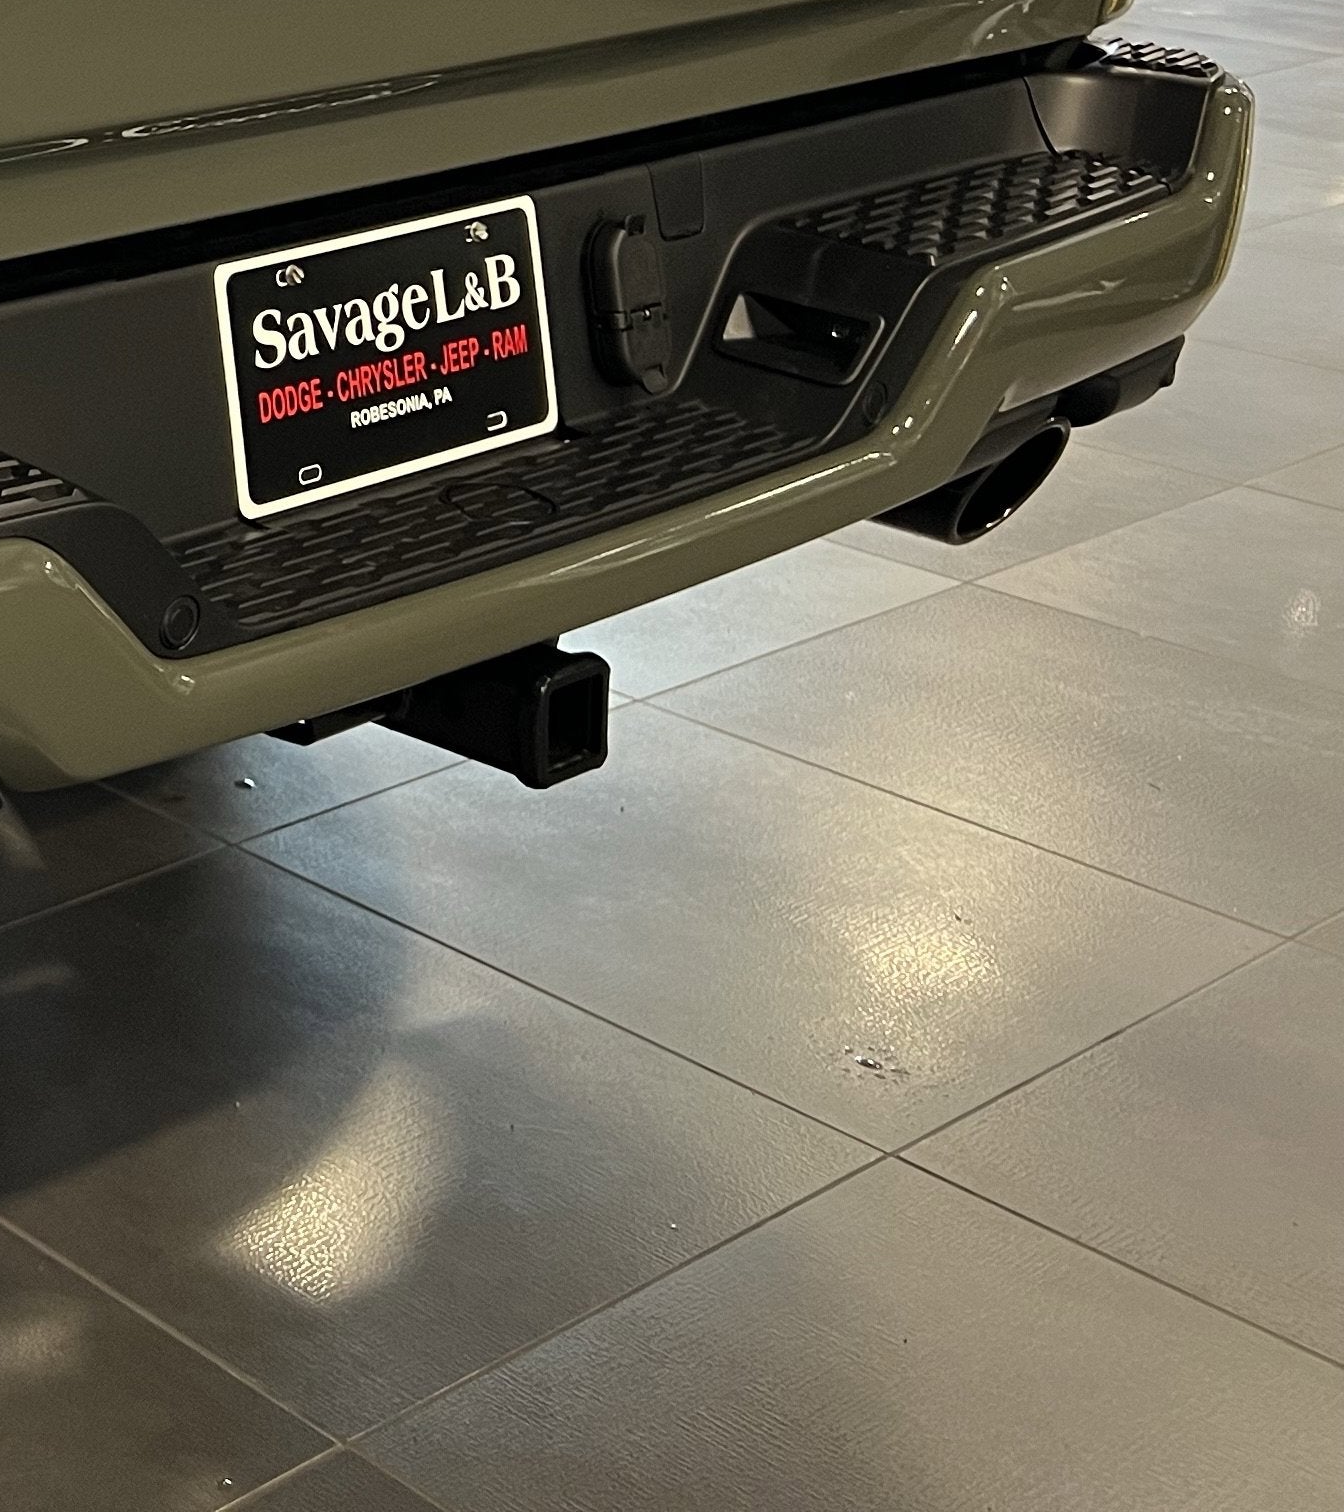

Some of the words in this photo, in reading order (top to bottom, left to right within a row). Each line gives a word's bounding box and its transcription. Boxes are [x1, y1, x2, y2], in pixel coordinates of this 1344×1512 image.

[258, 378, 324, 424] DODGE
[337, 352, 426, 403] CHRYSLER
[440, 337, 480, 375] JEEP
[492, 324, 528, 361] RAM
[350, 393, 433, 429] ROBESONIA,
[433, 386, 452, 405] PA
